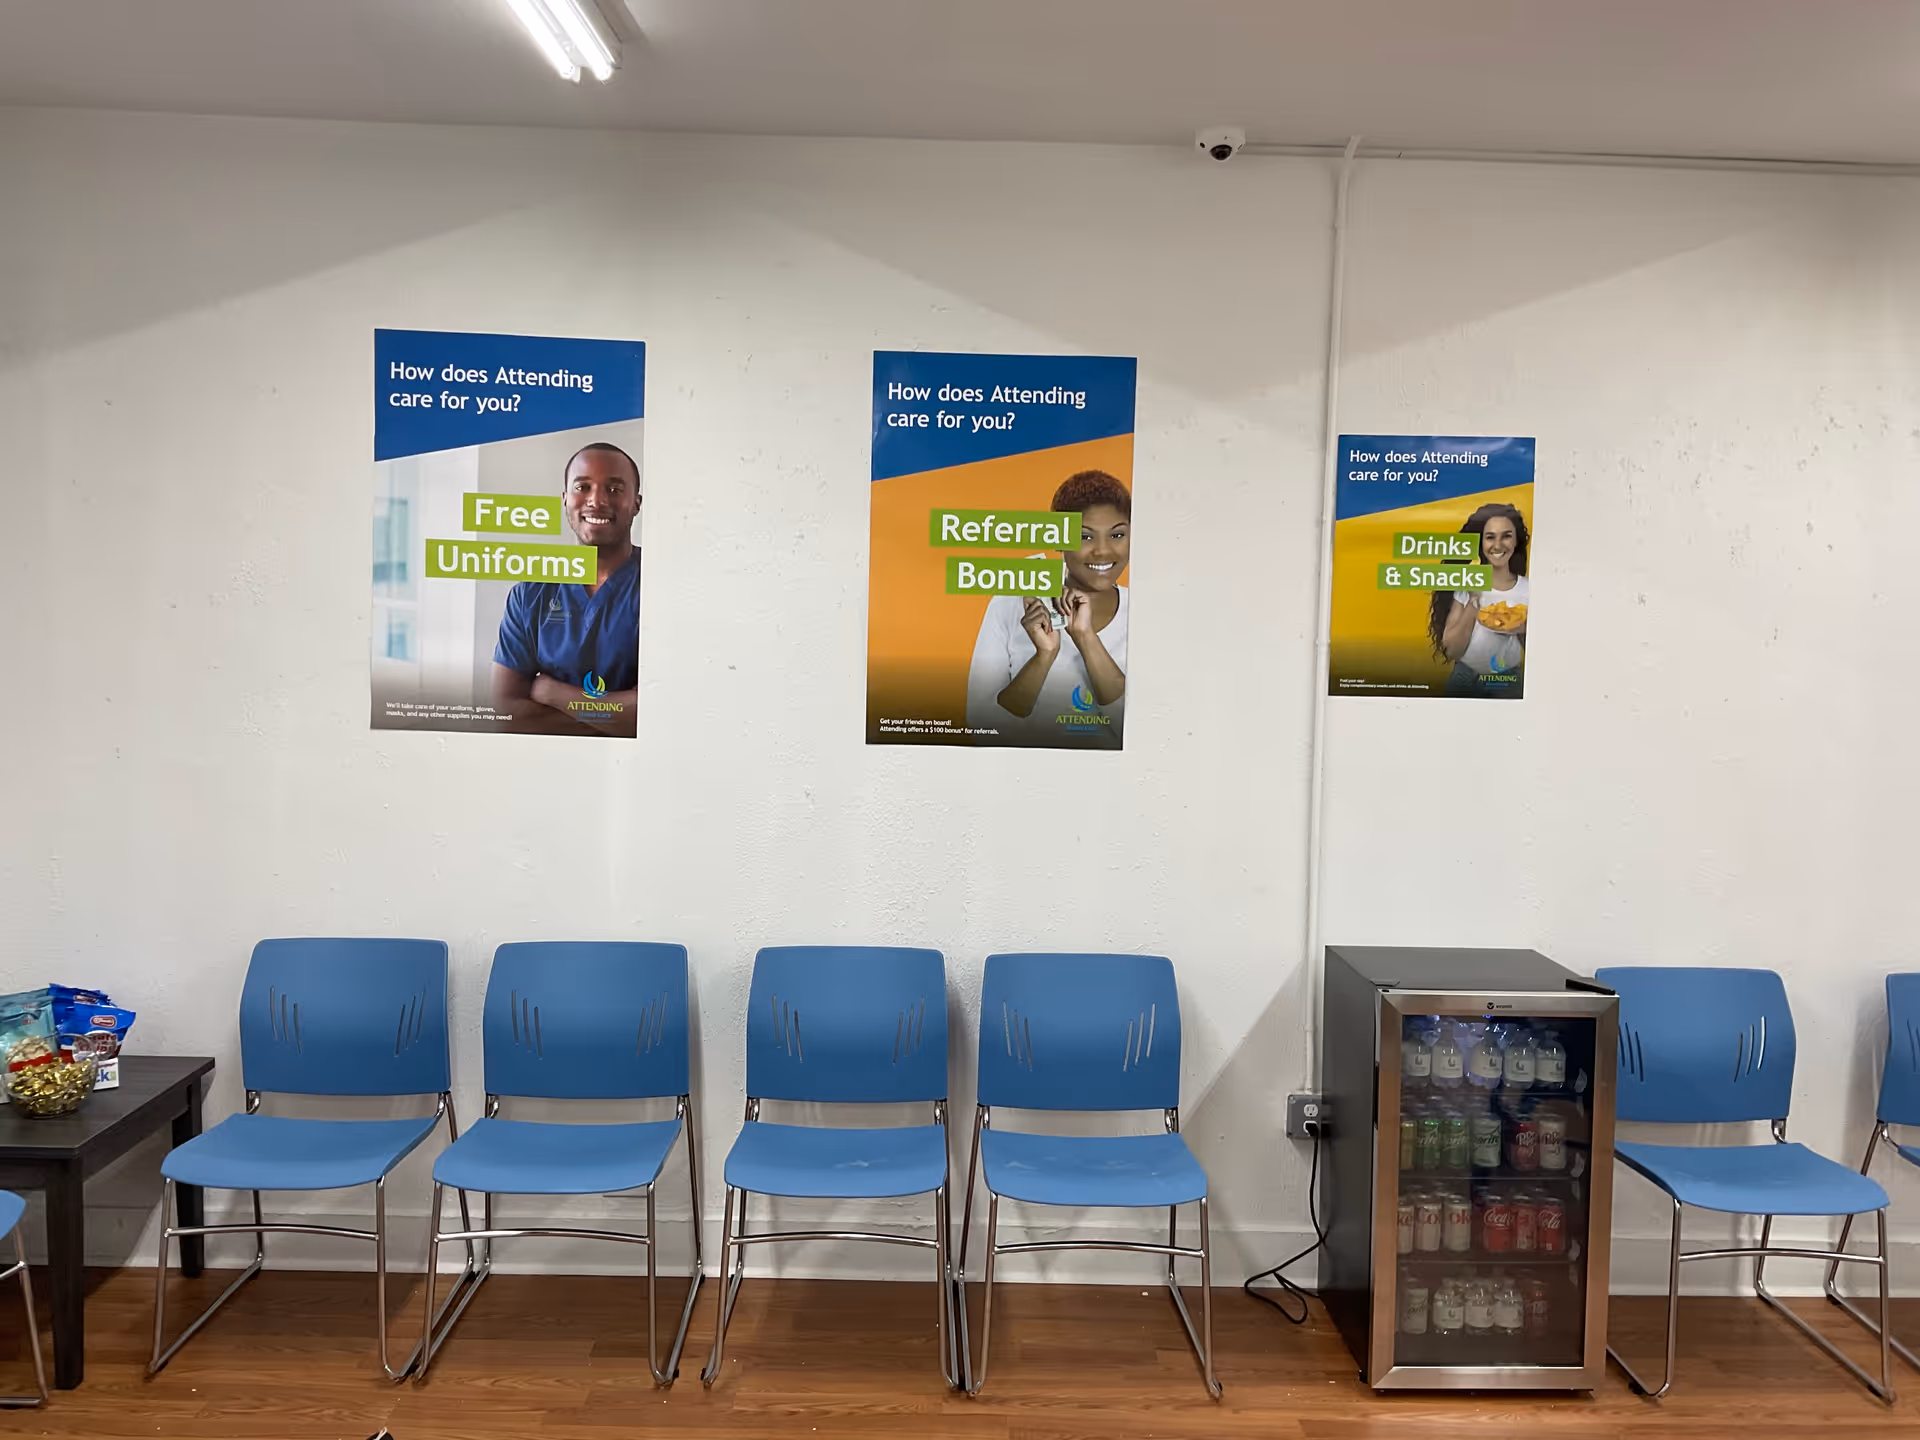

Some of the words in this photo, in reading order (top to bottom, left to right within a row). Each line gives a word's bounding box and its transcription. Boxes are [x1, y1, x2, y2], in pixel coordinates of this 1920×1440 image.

[390, 361, 434, 381] How
[441, 364, 488, 383] does
[495, 366, 593, 393] Attending
[389, 392, 433, 408] care
[440, 391, 469, 409] for
[476, 394, 521, 414] you?
[888, 382, 931, 400] How
[938, 383, 983, 402] does
[990, 385, 1086, 409] Attending
[887, 412, 930, 427] care
[936, 410, 965, 428] for
[972, 412, 1015, 433] you?
[1350, 450, 1380, 463] How
[1385, 450, 1417, 463] does
[1421, 451, 1488, 467] Attending
[1349, 470, 1379, 481] care
[1383, 469, 1403, 481] for
[1408, 469, 1439, 484] you?
[475, 498, 550, 528] Free
[941, 514, 1070, 545] Referral
[1401, 535, 1471, 556] Drinks
[437, 544, 586, 578] Uniforms
[958, 562, 1052, 591] Bonus
[1385, 566, 1401, 586] &
[1409, 566, 1485, 587] Snacks
[1478, 674, 1517, 682] ATTENDING
[567, 701, 624, 712] ATTENDING
[879, 717, 890, 725] Get
[905, 718, 924, 726] friends
[934, 719, 952, 727] board!
[879, 725, 907, 733] Attending
[1055, 715, 1110, 725] ATTENDING
